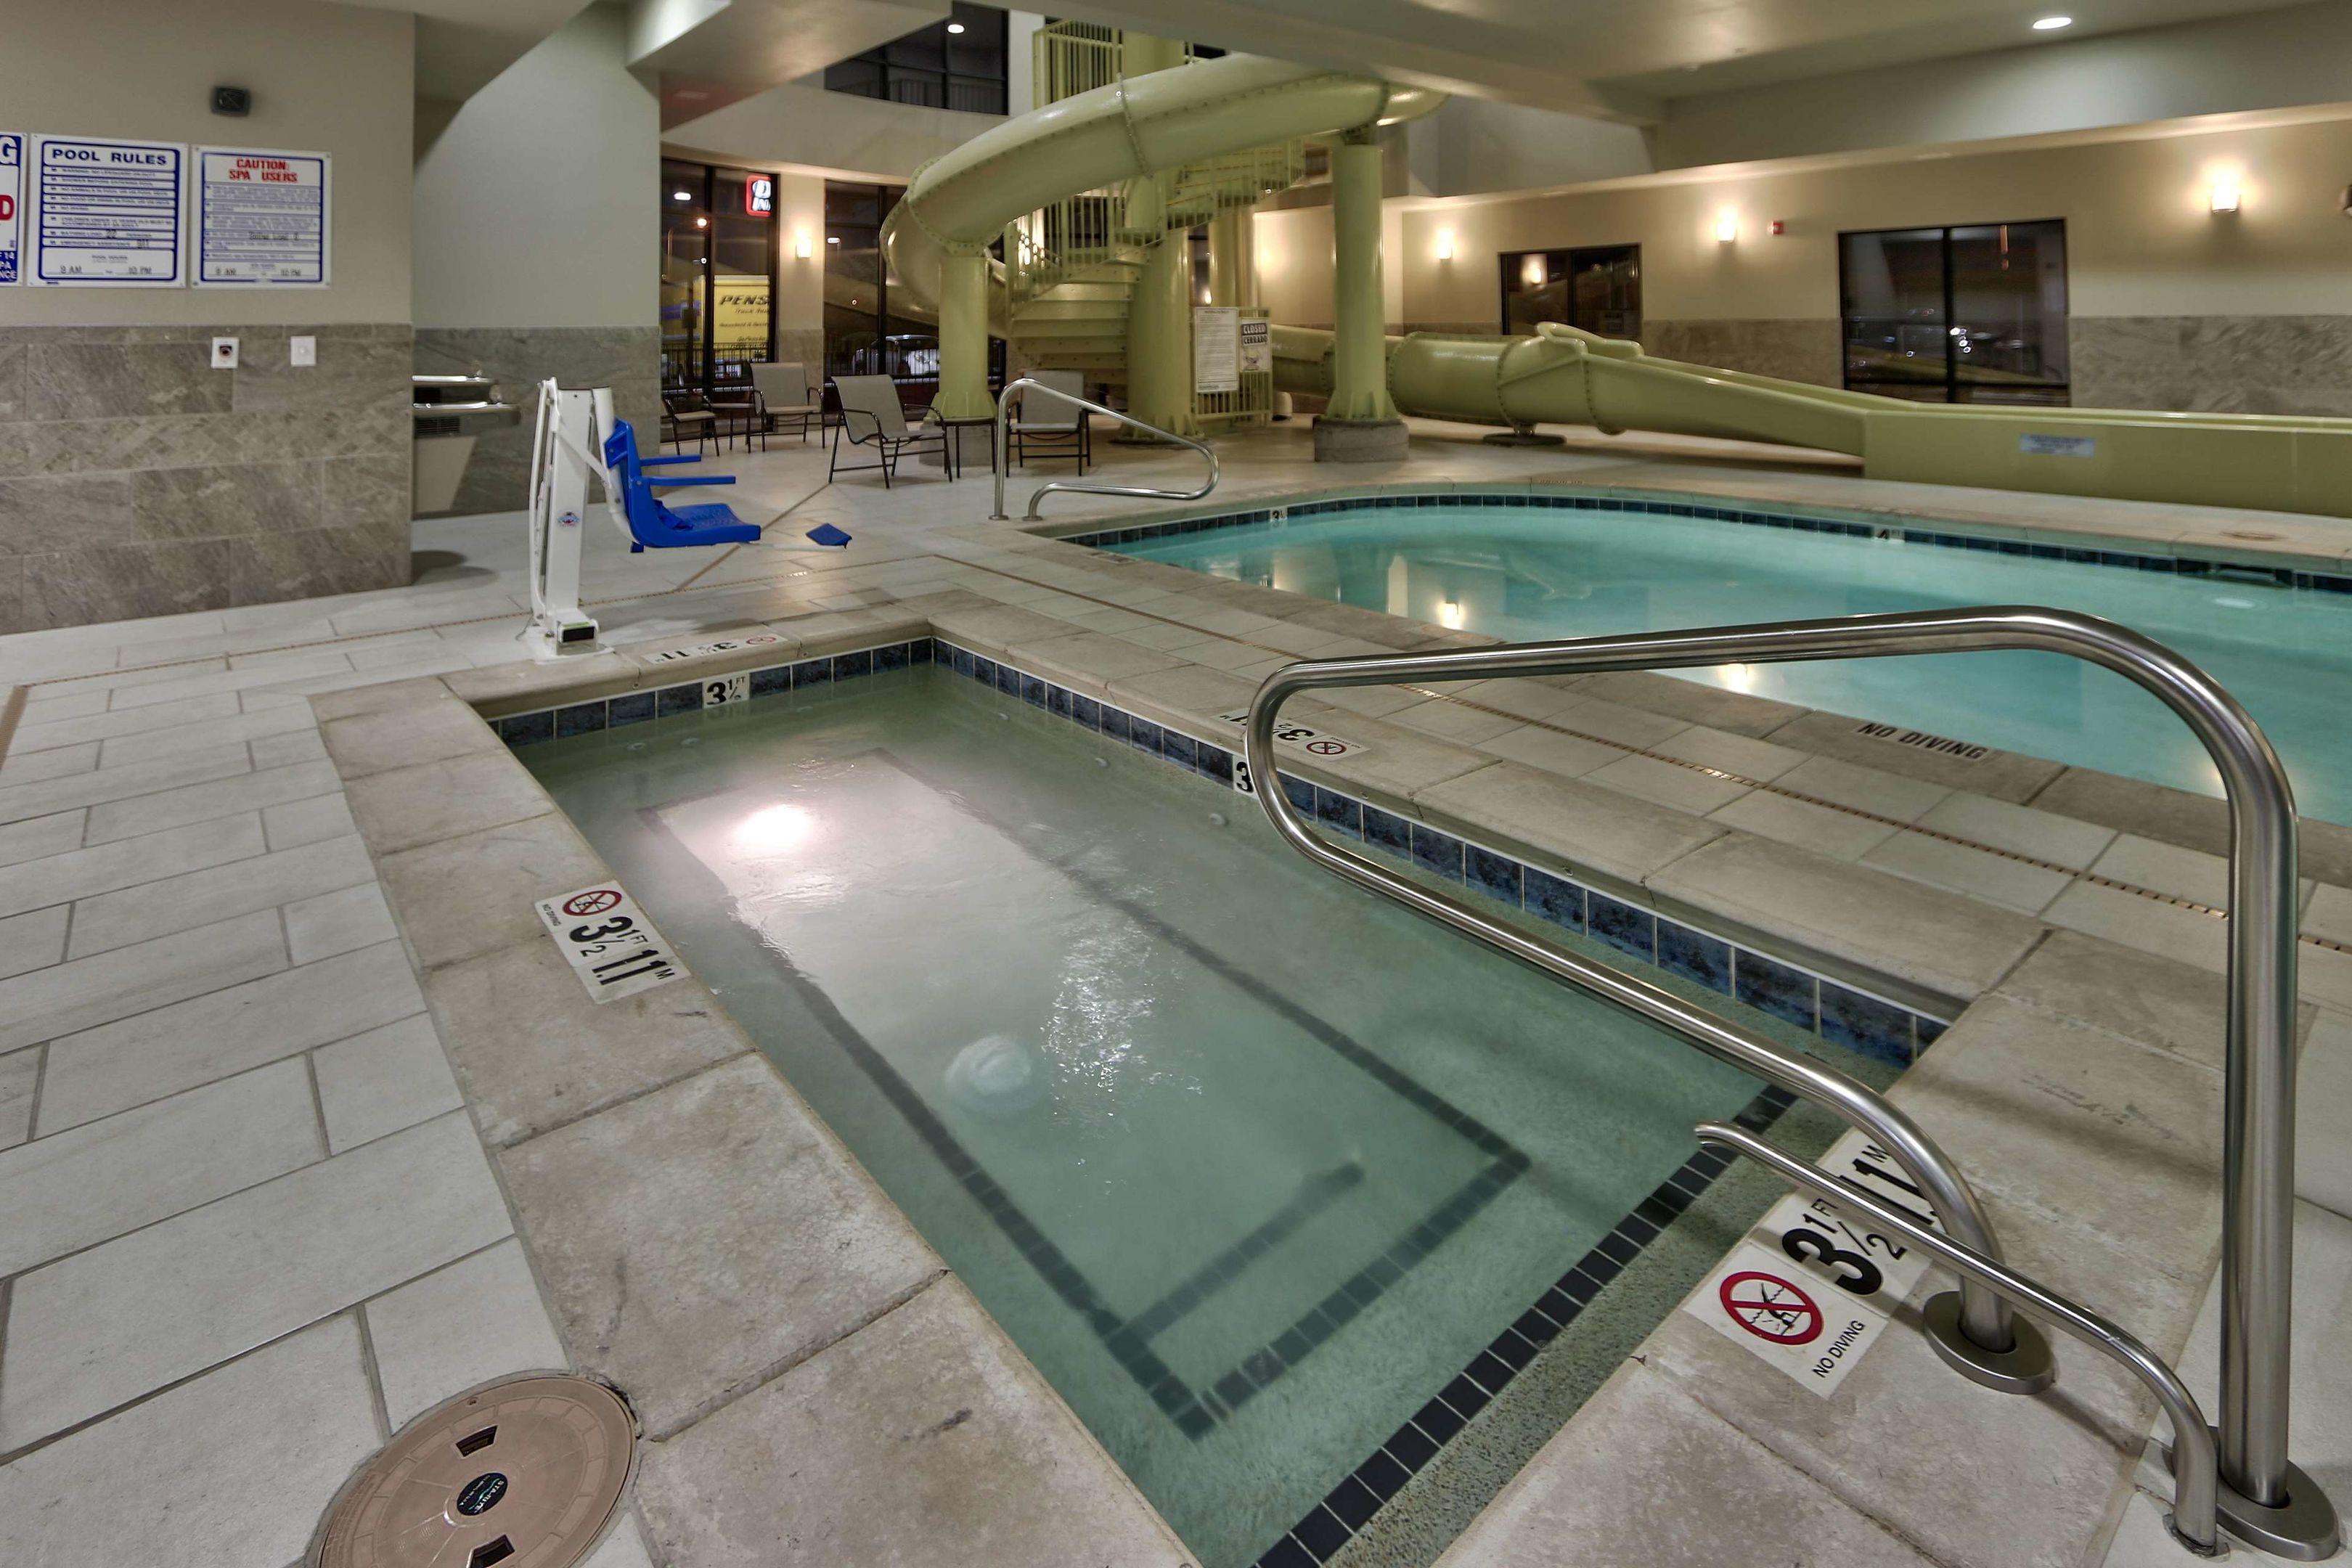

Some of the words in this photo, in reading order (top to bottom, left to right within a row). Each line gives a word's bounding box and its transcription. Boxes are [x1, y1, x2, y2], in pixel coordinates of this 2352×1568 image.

[52, 148, 101, 161] POOL
[110, 152, 167, 166] RULES
[229, 168, 251, 181] SPA
[261, 171, 298, 183] USERS
[707, 682, 727, 705] 3
[735, 676, 746, 685] FT
[1857, 723, 1898, 738] NO
[1898, 732, 1989, 759] DIVING
[1236, 761, 1254, 793] 3
[569, 916, 633, 943] 3
[629, 935, 649, 945] FT
[654, 968, 675, 980] M
[1781, 1228, 1882, 1296] 3
[1812, 1357, 1835, 1379] NO
[1828, 1320, 1866, 1359] DIVING
